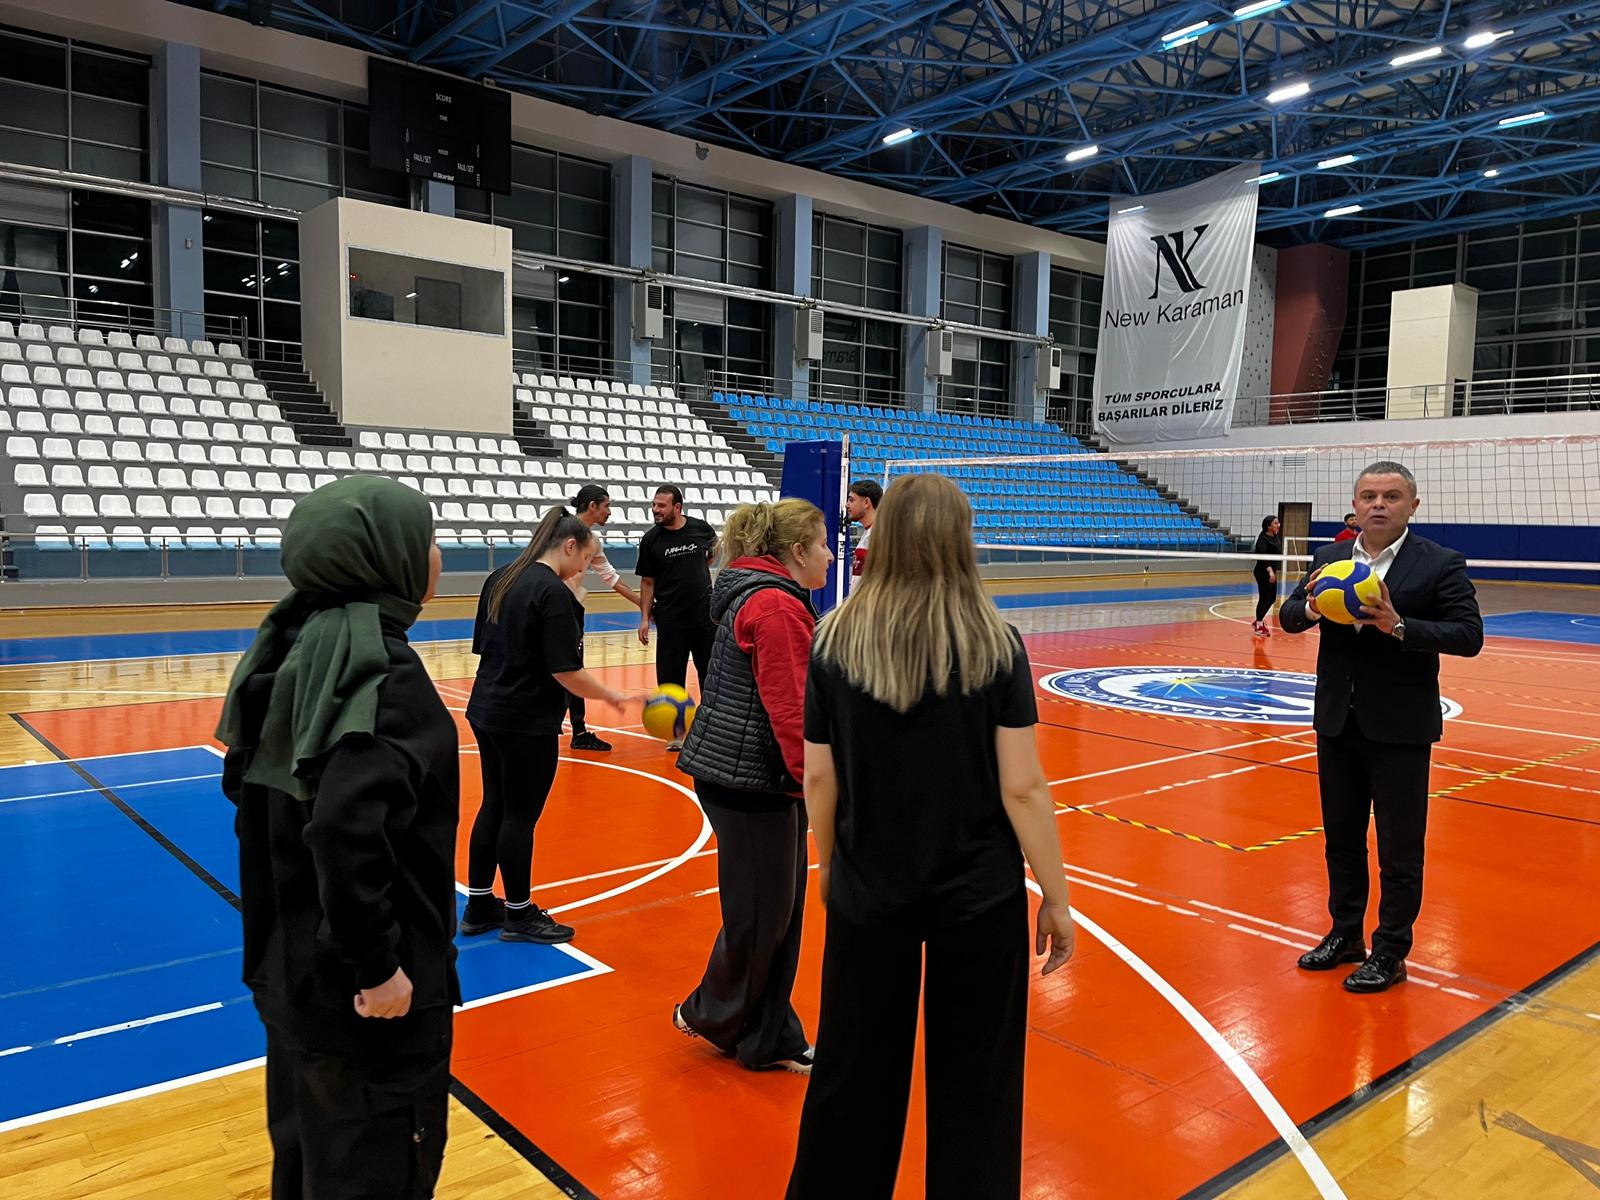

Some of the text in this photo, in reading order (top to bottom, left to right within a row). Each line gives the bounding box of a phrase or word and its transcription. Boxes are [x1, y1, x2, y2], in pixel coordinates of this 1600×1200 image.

[436, 93, 452, 103] SCORE
[1148, 223, 1209, 299] NK
[1104, 288, 1244, 329] New Karaman
[1105, 382, 1221, 405] TÜM SPORCULARA
[1098, 398, 1224, 423] BAŞARILAR DİLERİZ
